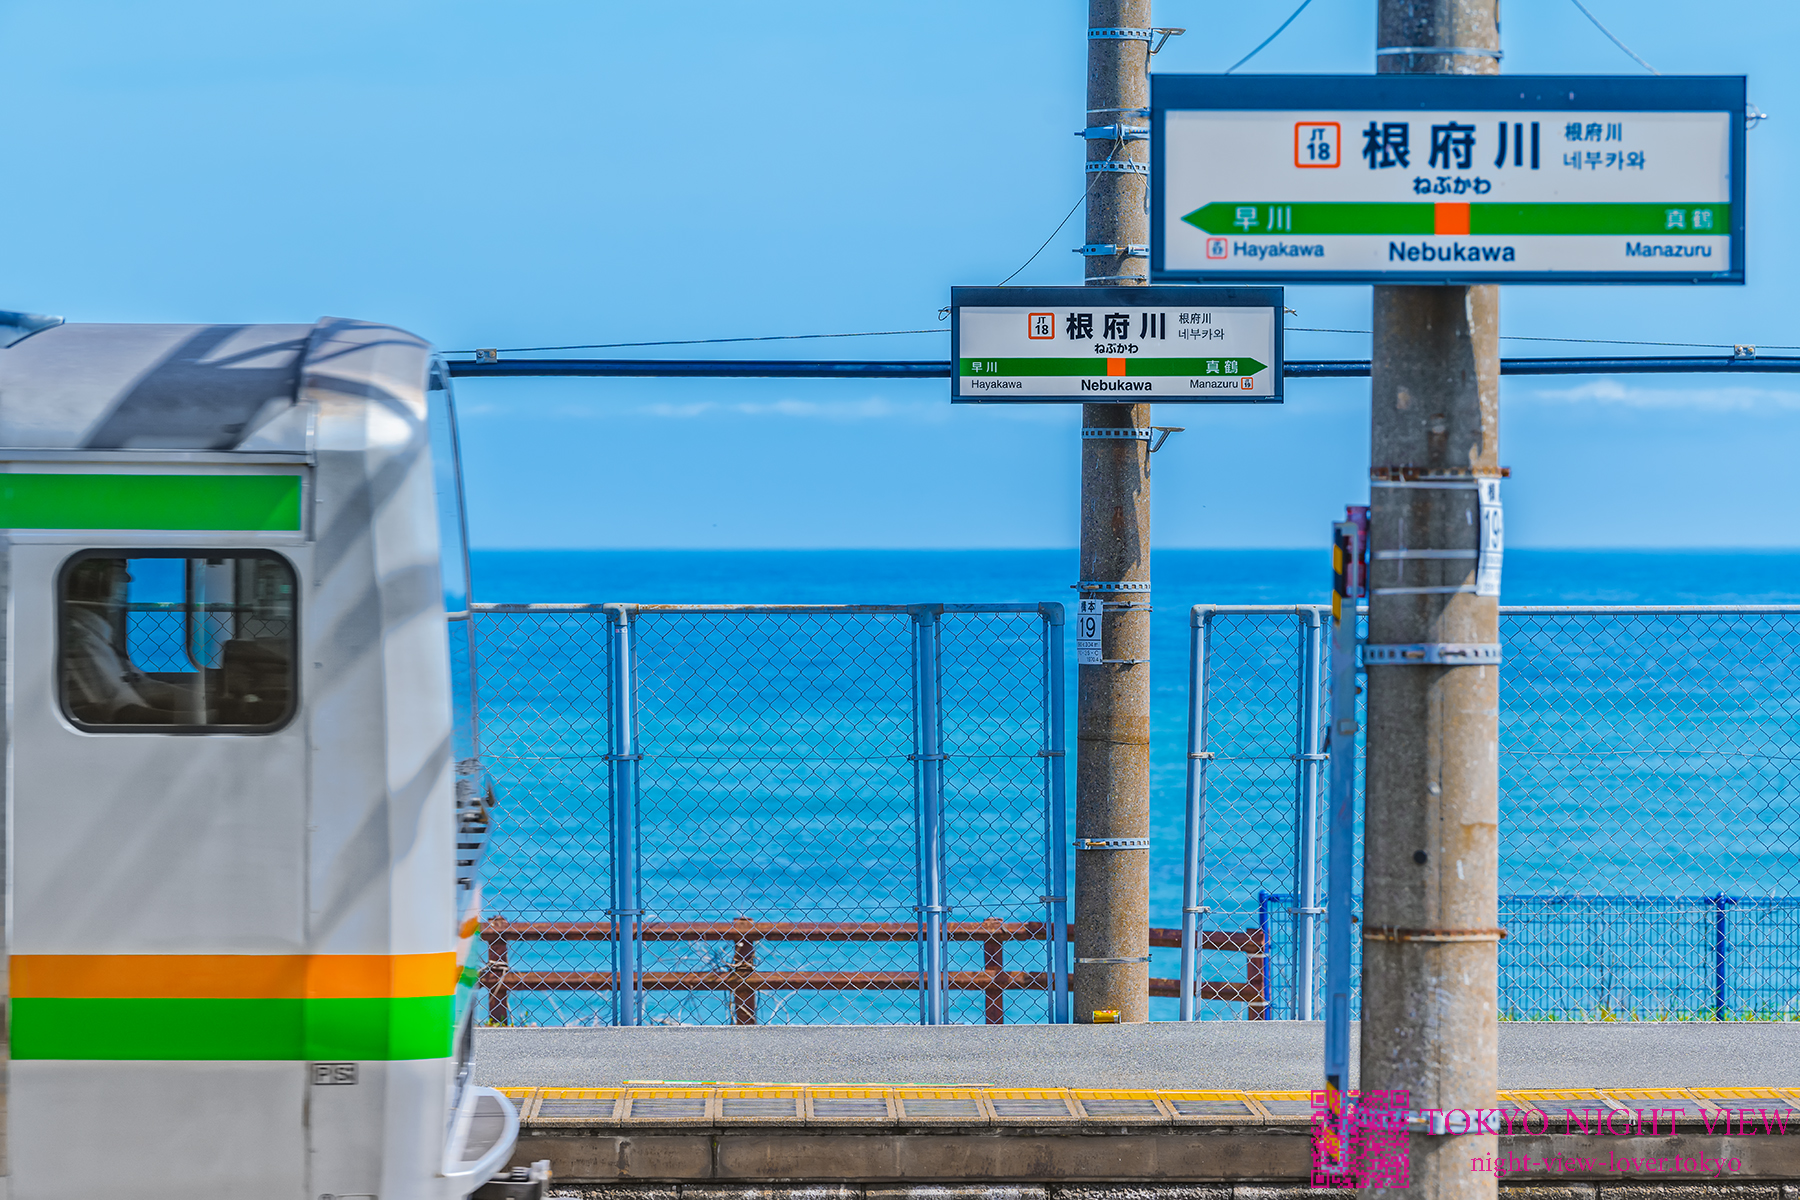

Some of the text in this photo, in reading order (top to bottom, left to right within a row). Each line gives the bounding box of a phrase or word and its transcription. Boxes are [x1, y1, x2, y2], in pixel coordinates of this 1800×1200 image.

[1310, 128, 1326, 141] JT
[1564, 122, 1622, 142] 根府川
[1306, 142, 1331, 161] 18
[1362, 121, 1540, 170] 根府川
[1563, 151, 1646, 171] 네부카와
[1412, 176, 1492, 195] ねぶかわ
[1234, 206, 1713, 231] 早川 真鶴
[1233, 241, 1325, 260] Hayakawa
[1388, 241, 1515, 262] Nebukawa
[1625, 241, 1712, 258] Manazuru
[1036, 316, 1047, 325] JT
[1065, 312, 1167, 341] 根府川
[1178, 312, 1212, 325] 根府川
[1034, 325, 1050, 335] 18
[1178, 328, 1225, 341] 네부카와
[1094, 343, 1139, 355] ねぶかわ
[971, 360, 1239, 374] 早川 真鶴
[971, 379, 1023, 391] Hayakawa
[1081, 379, 1153, 391] Nebukawa
[1189, 379, 1239, 390] Manazuru
[1483, 509, 1501, 550] 19
[1080, 616, 1096, 638] 19
